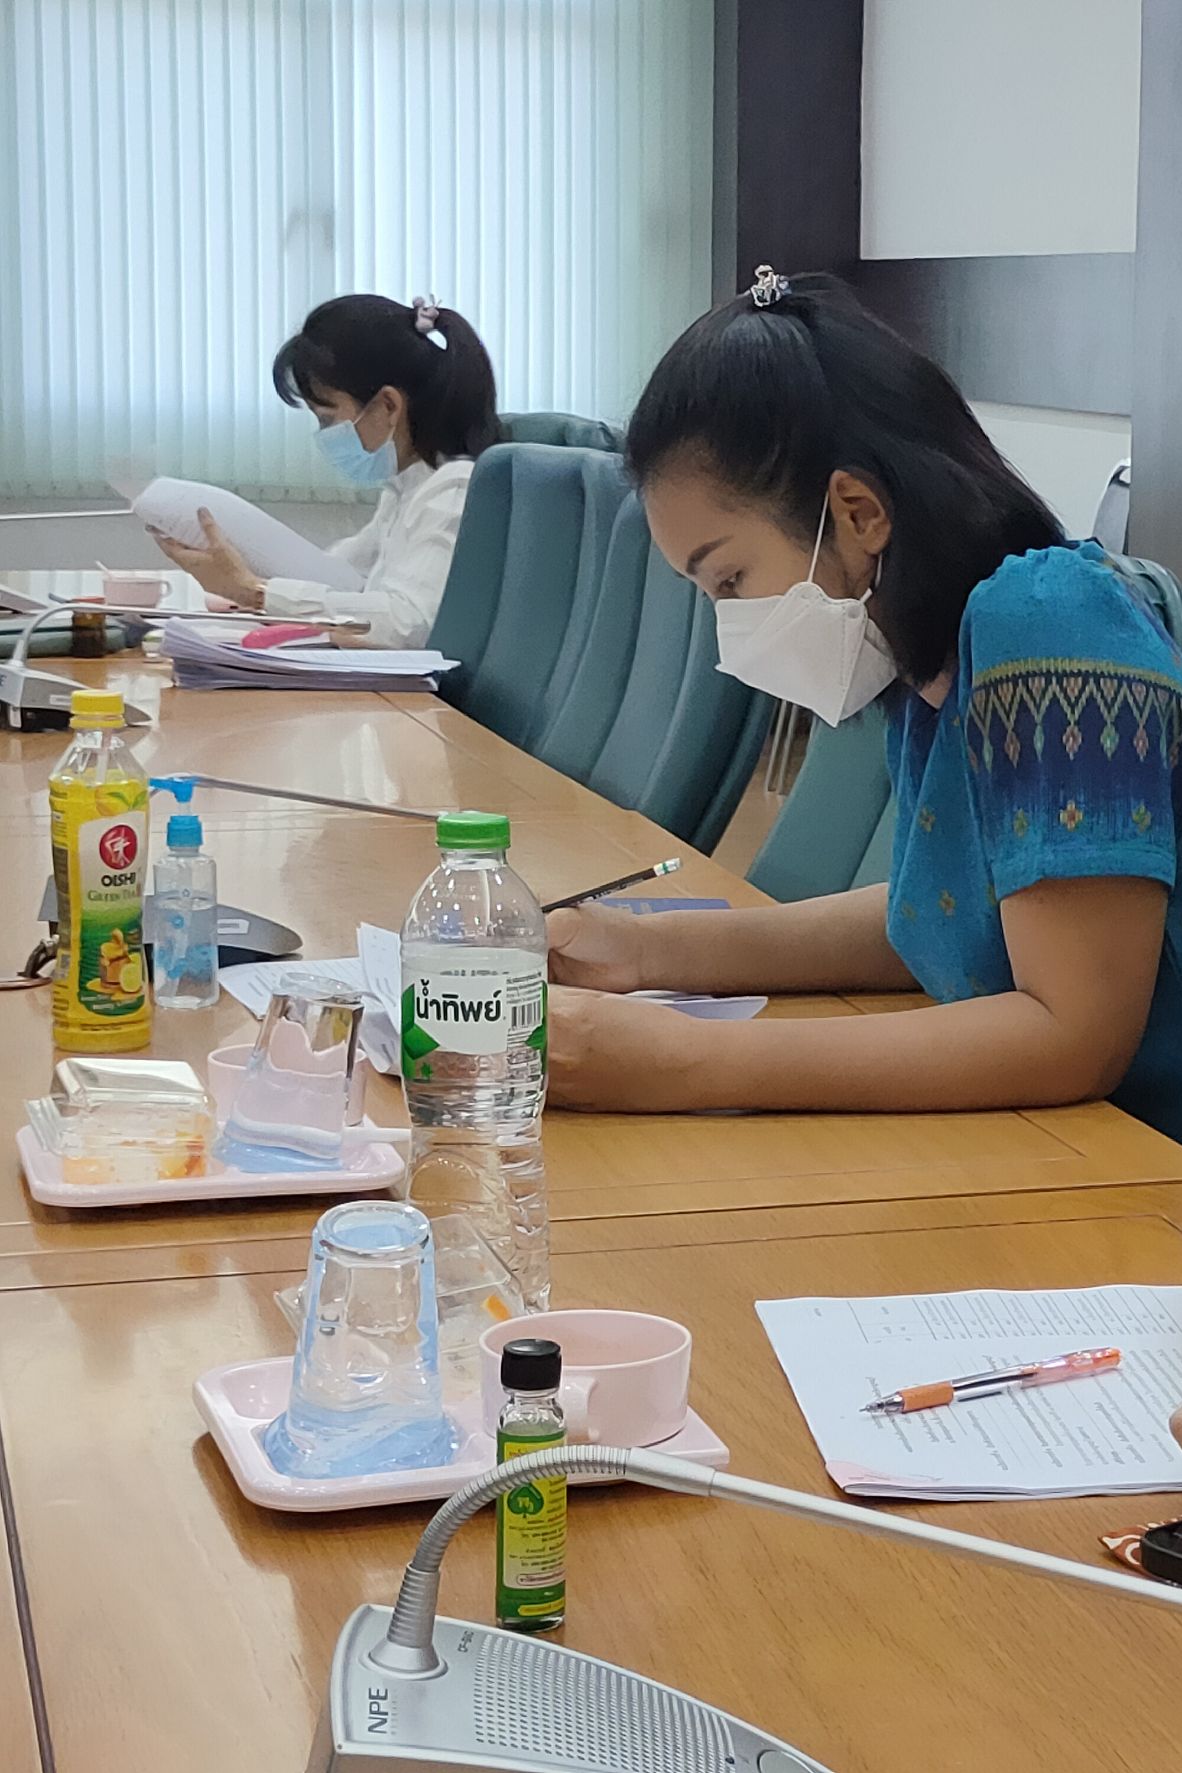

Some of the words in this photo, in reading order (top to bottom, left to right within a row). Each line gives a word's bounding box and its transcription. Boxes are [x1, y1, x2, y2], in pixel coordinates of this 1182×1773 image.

[416, 978, 502, 1022] น้ำทิพย์
[367, 1687, 389, 1734] NPE
